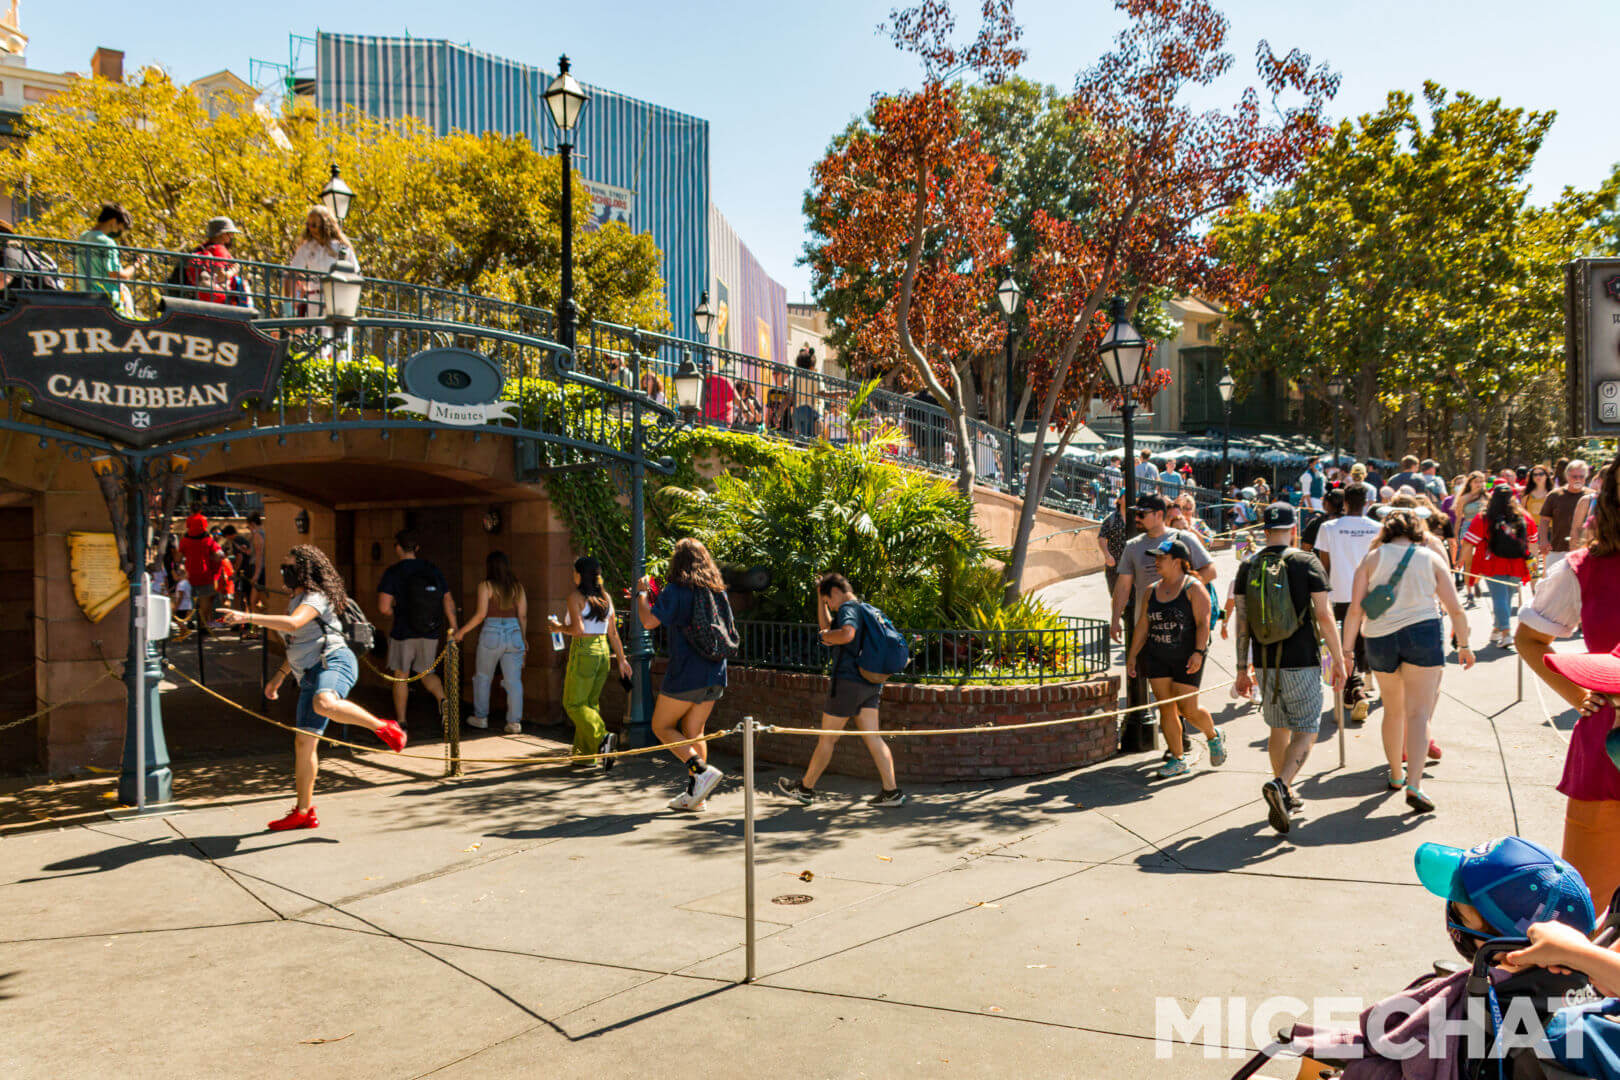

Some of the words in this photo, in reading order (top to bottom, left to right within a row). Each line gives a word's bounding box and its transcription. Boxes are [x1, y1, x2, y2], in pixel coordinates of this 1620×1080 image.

[28, 328, 240, 367] PIRATES
[124, 358, 138, 376] of
[137, 364, 158, 381] the
[47, 374, 229, 408] CARIBBEAN
[436, 407, 484, 420] Minutes
